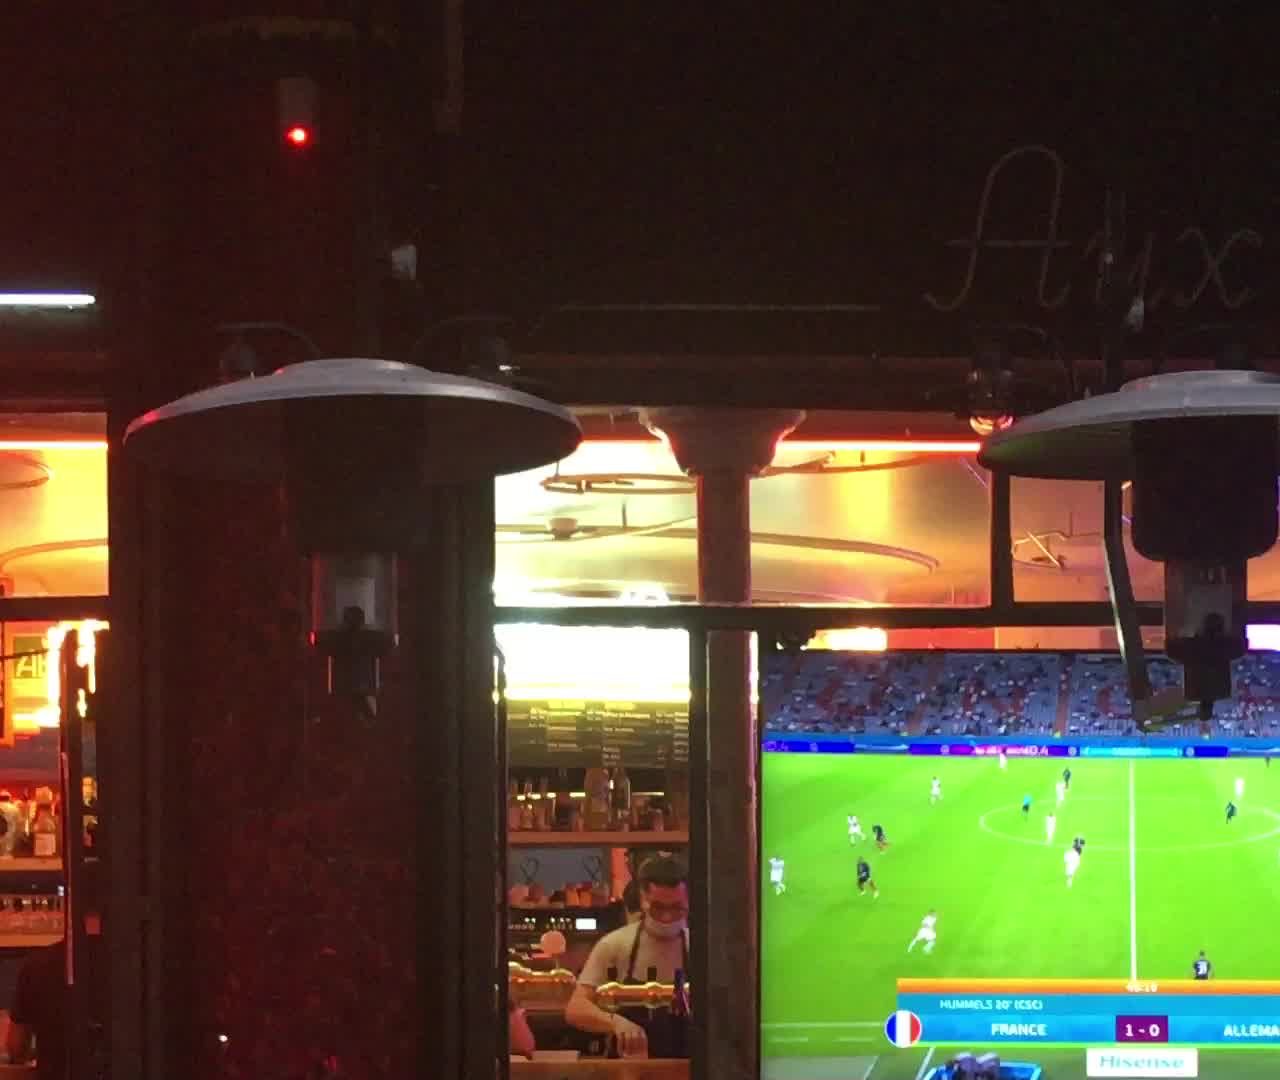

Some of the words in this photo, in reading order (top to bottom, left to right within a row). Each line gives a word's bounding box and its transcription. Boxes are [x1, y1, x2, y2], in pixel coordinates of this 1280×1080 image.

[940, 999, 992, 1010] HUMMELS
[991, 1023, 1047, 1036] FRANCE
[1125, 1024, 1134, 1036] 1
[1149, 1024, 1160, 1037] 0
[1100, 1055, 1184, 1069] Hisense
